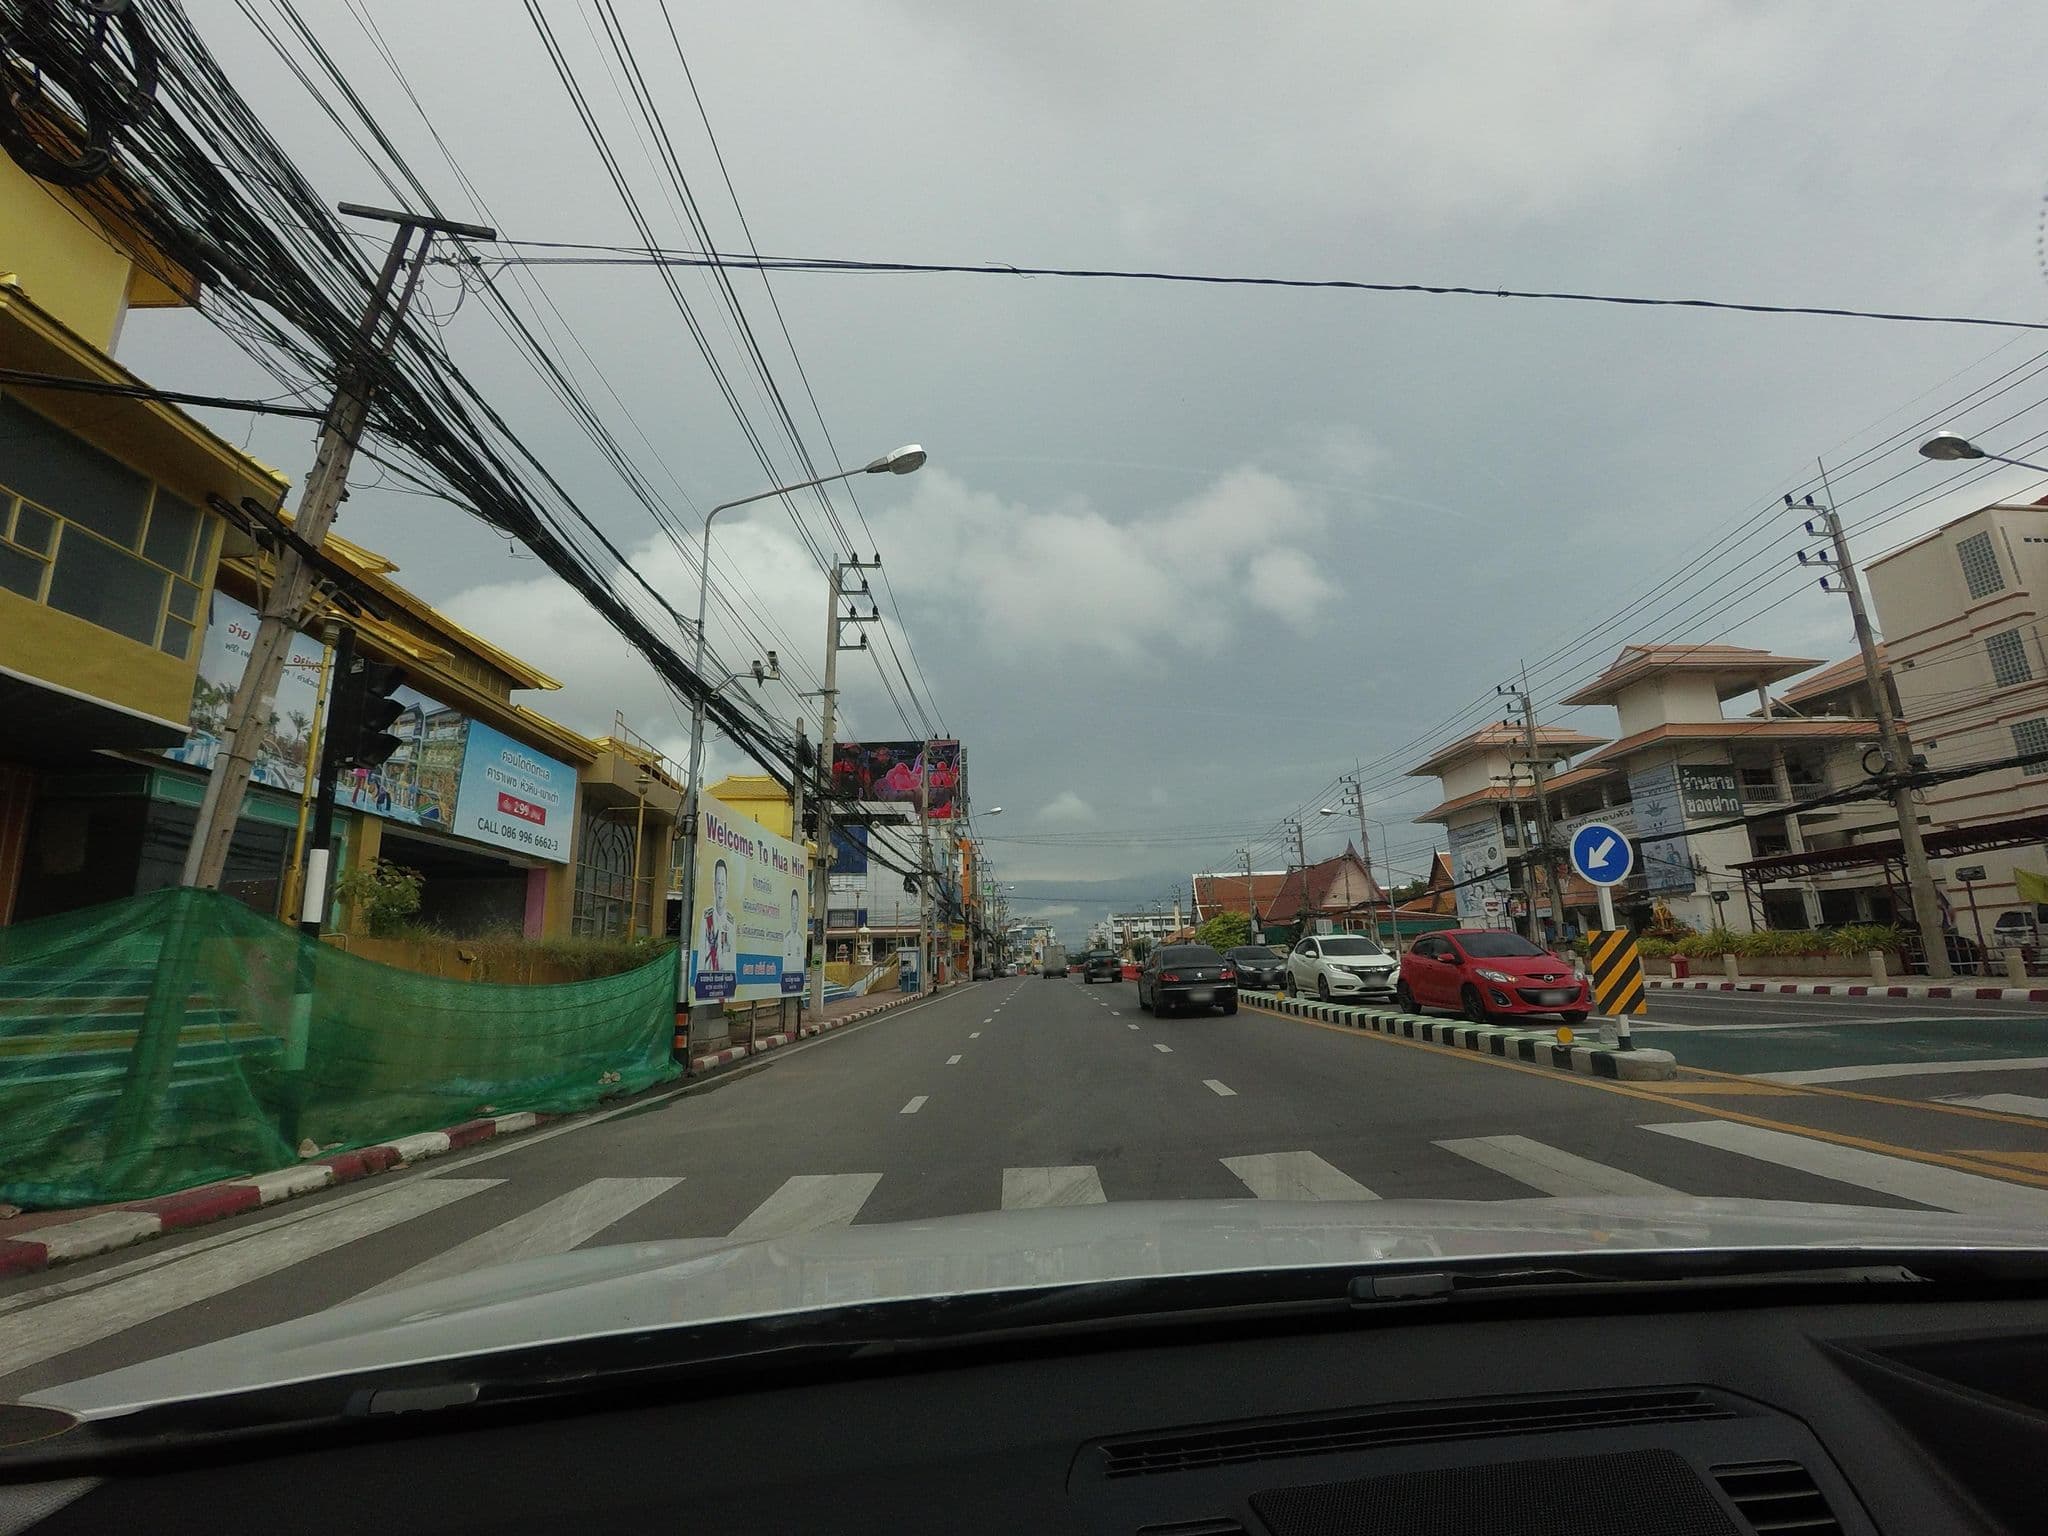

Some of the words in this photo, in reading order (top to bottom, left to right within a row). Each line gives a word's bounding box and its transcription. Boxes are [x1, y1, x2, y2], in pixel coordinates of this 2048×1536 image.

[502, 751, 550, 780] คอนโดติดทะเล
[1682, 769, 1735, 791] ร้านขาย
[1687, 796, 1740, 813] ของฝาก
[477, 817, 498, 834] CALL
[501, 824, 517, 839] 086
[519, 830, 532, 845] 996
[534, 835, 559, 851] 6662-3
[706, 812, 754, 858] Welcome
[757, 840, 769, 863] To
[771, 847, 788, 872] Hua
[791, 856, 805, 878] Hin
